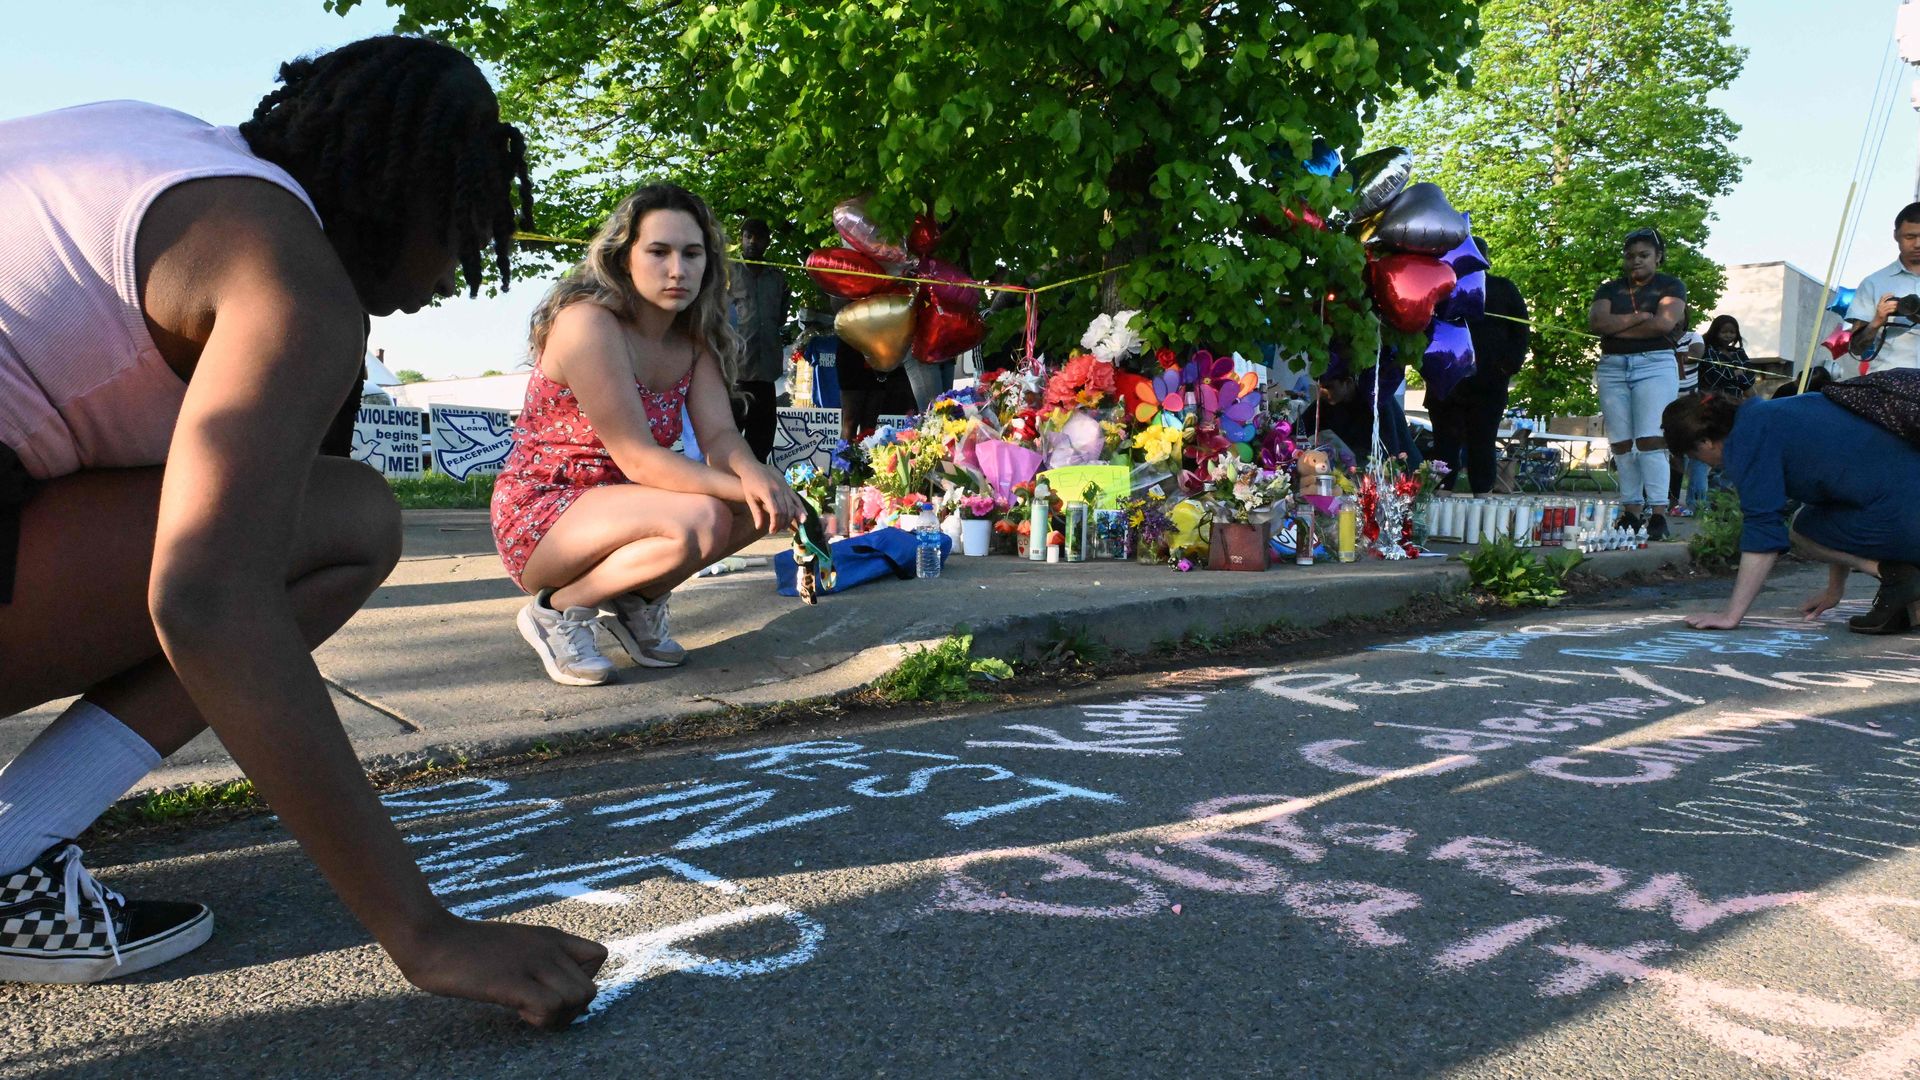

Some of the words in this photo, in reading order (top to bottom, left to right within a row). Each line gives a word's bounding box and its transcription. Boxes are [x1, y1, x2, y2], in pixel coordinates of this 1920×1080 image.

[376, 429, 418, 442] begins
[391, 443, 418, 453] with
[446, 439, 511, 467] PEACEPRINTS
[775, 439, 817, 463] PEACEPRINTS
[388, 456, 419, 472] ME!
[714, 740, 1122, 828] REST
[591, 779, 850, 851] IN
